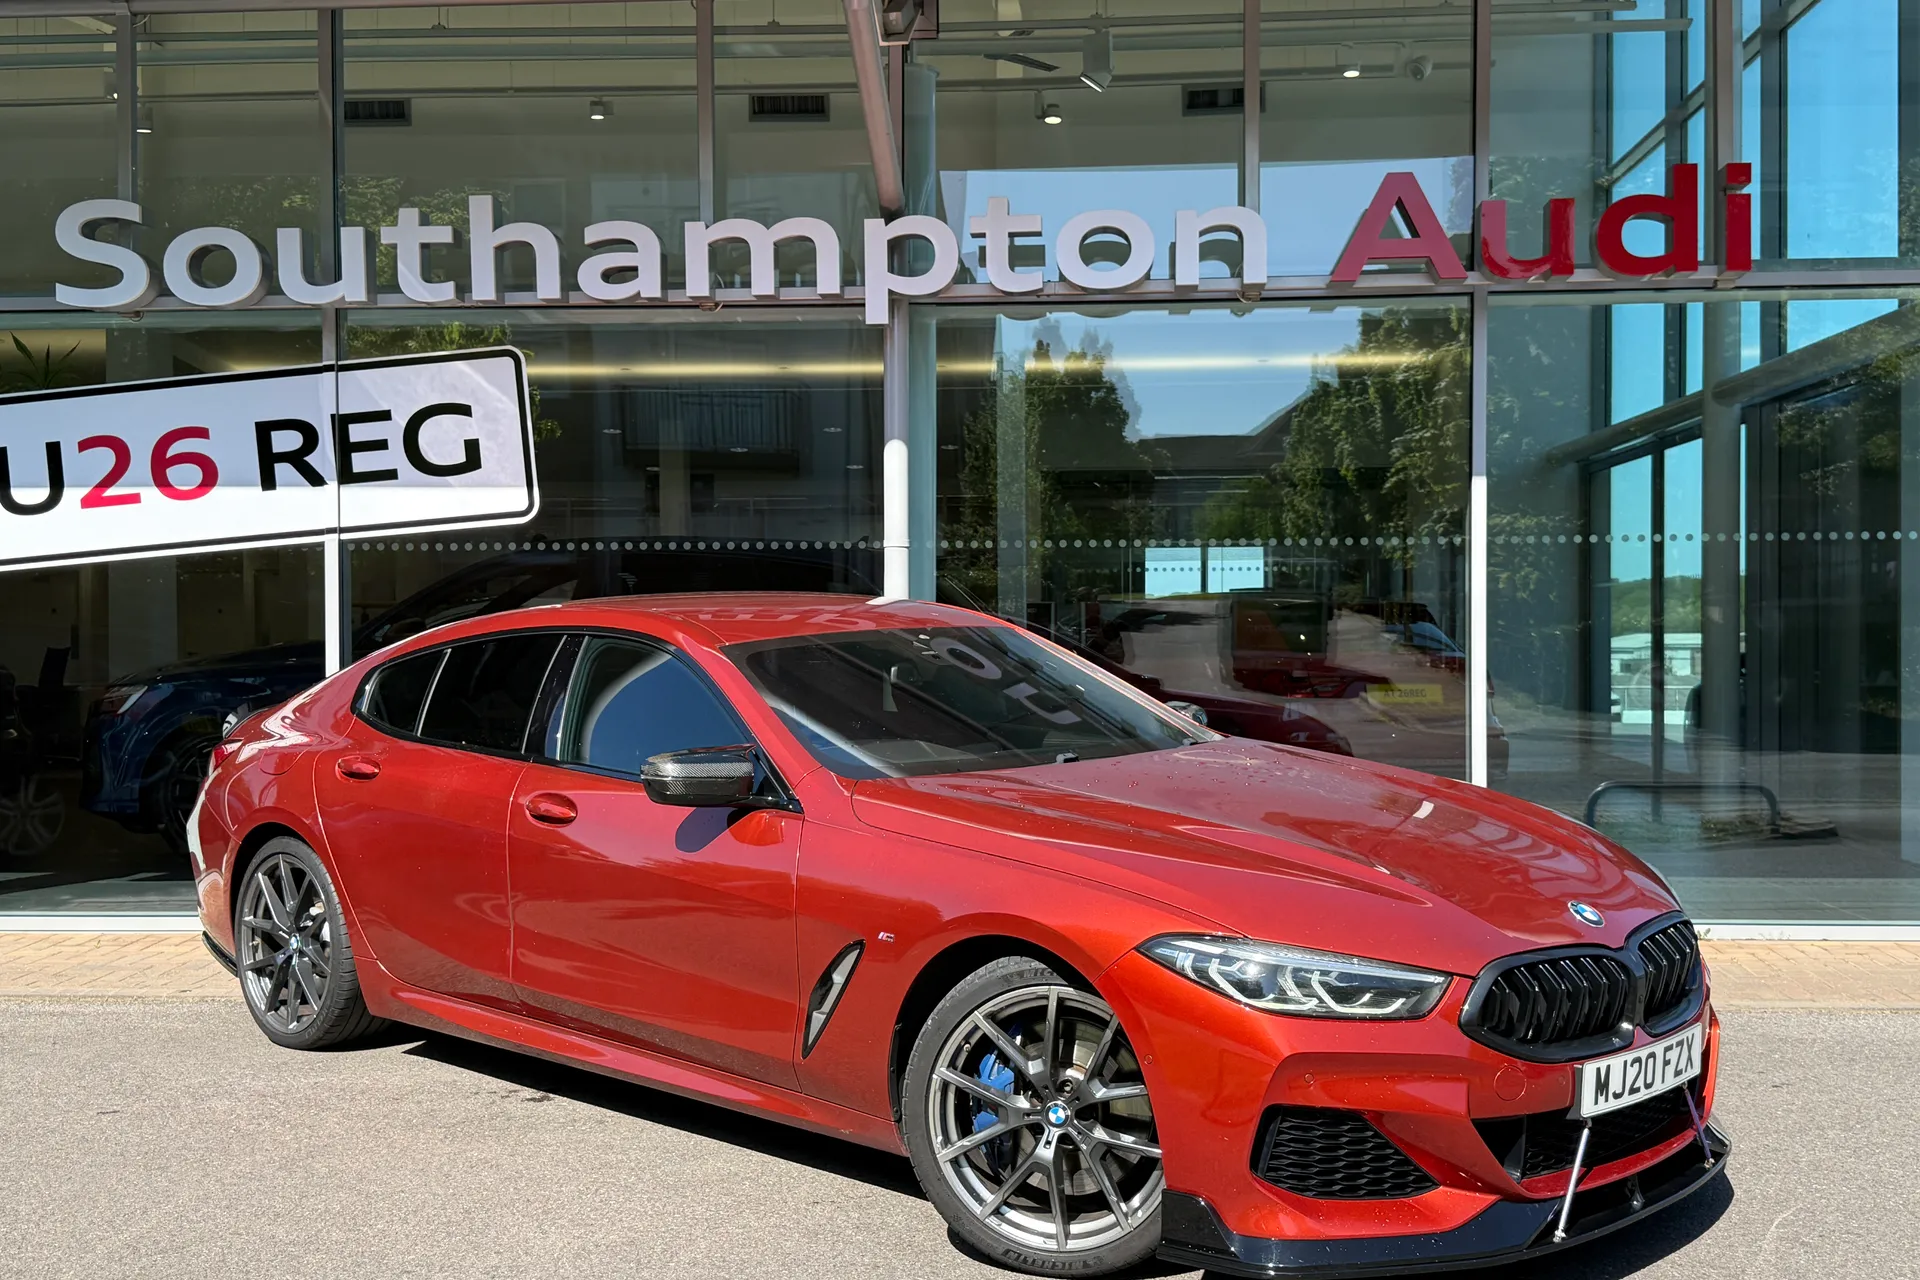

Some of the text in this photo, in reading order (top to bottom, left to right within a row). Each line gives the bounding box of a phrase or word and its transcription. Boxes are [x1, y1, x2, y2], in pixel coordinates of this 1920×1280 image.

[55, 162, 1752, 324] Southampton Audi
[0, 402, 482, 515] U26 REG
[1594, 1033, 1695, 1106] MJ20 FZX
